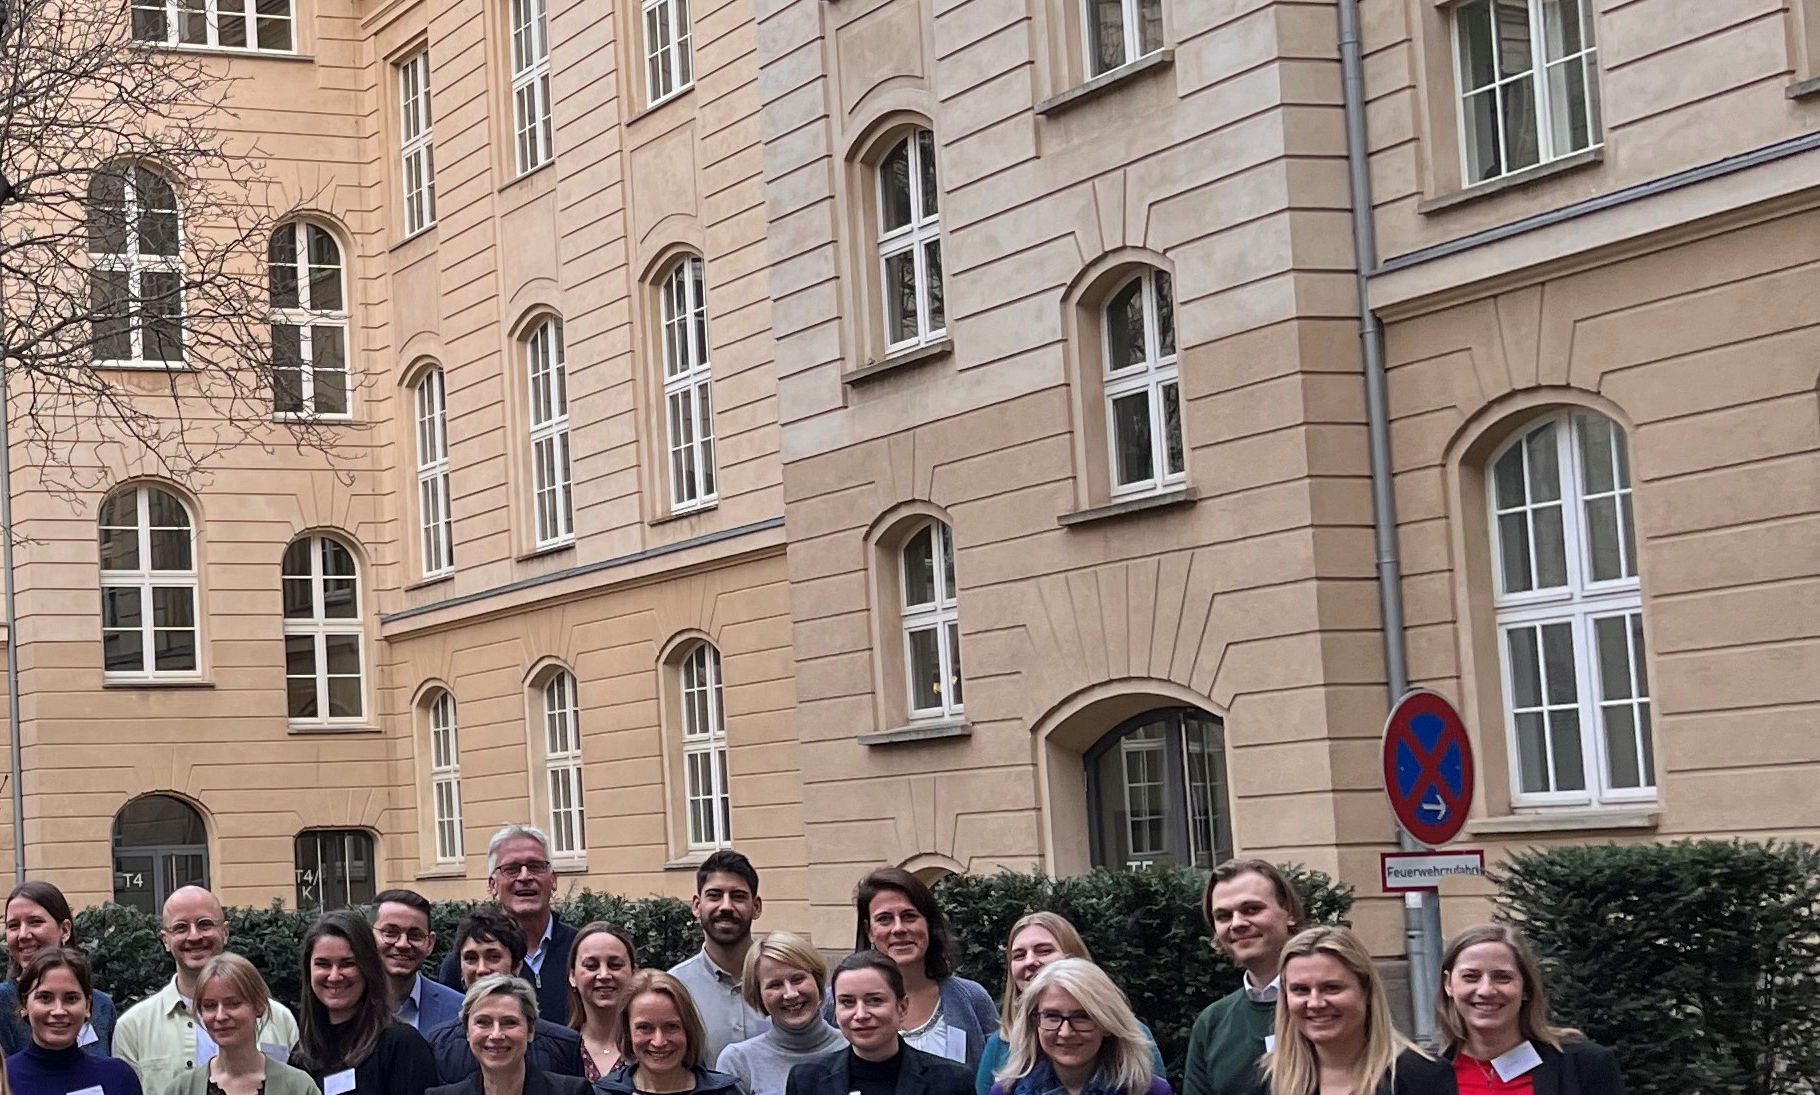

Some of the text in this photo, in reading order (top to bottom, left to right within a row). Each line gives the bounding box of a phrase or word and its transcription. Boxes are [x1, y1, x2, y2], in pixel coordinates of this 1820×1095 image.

[122, 872, 144, 888] T4
[295, 869, 319, 886] T4/
[302, 885, 314, 901] K
